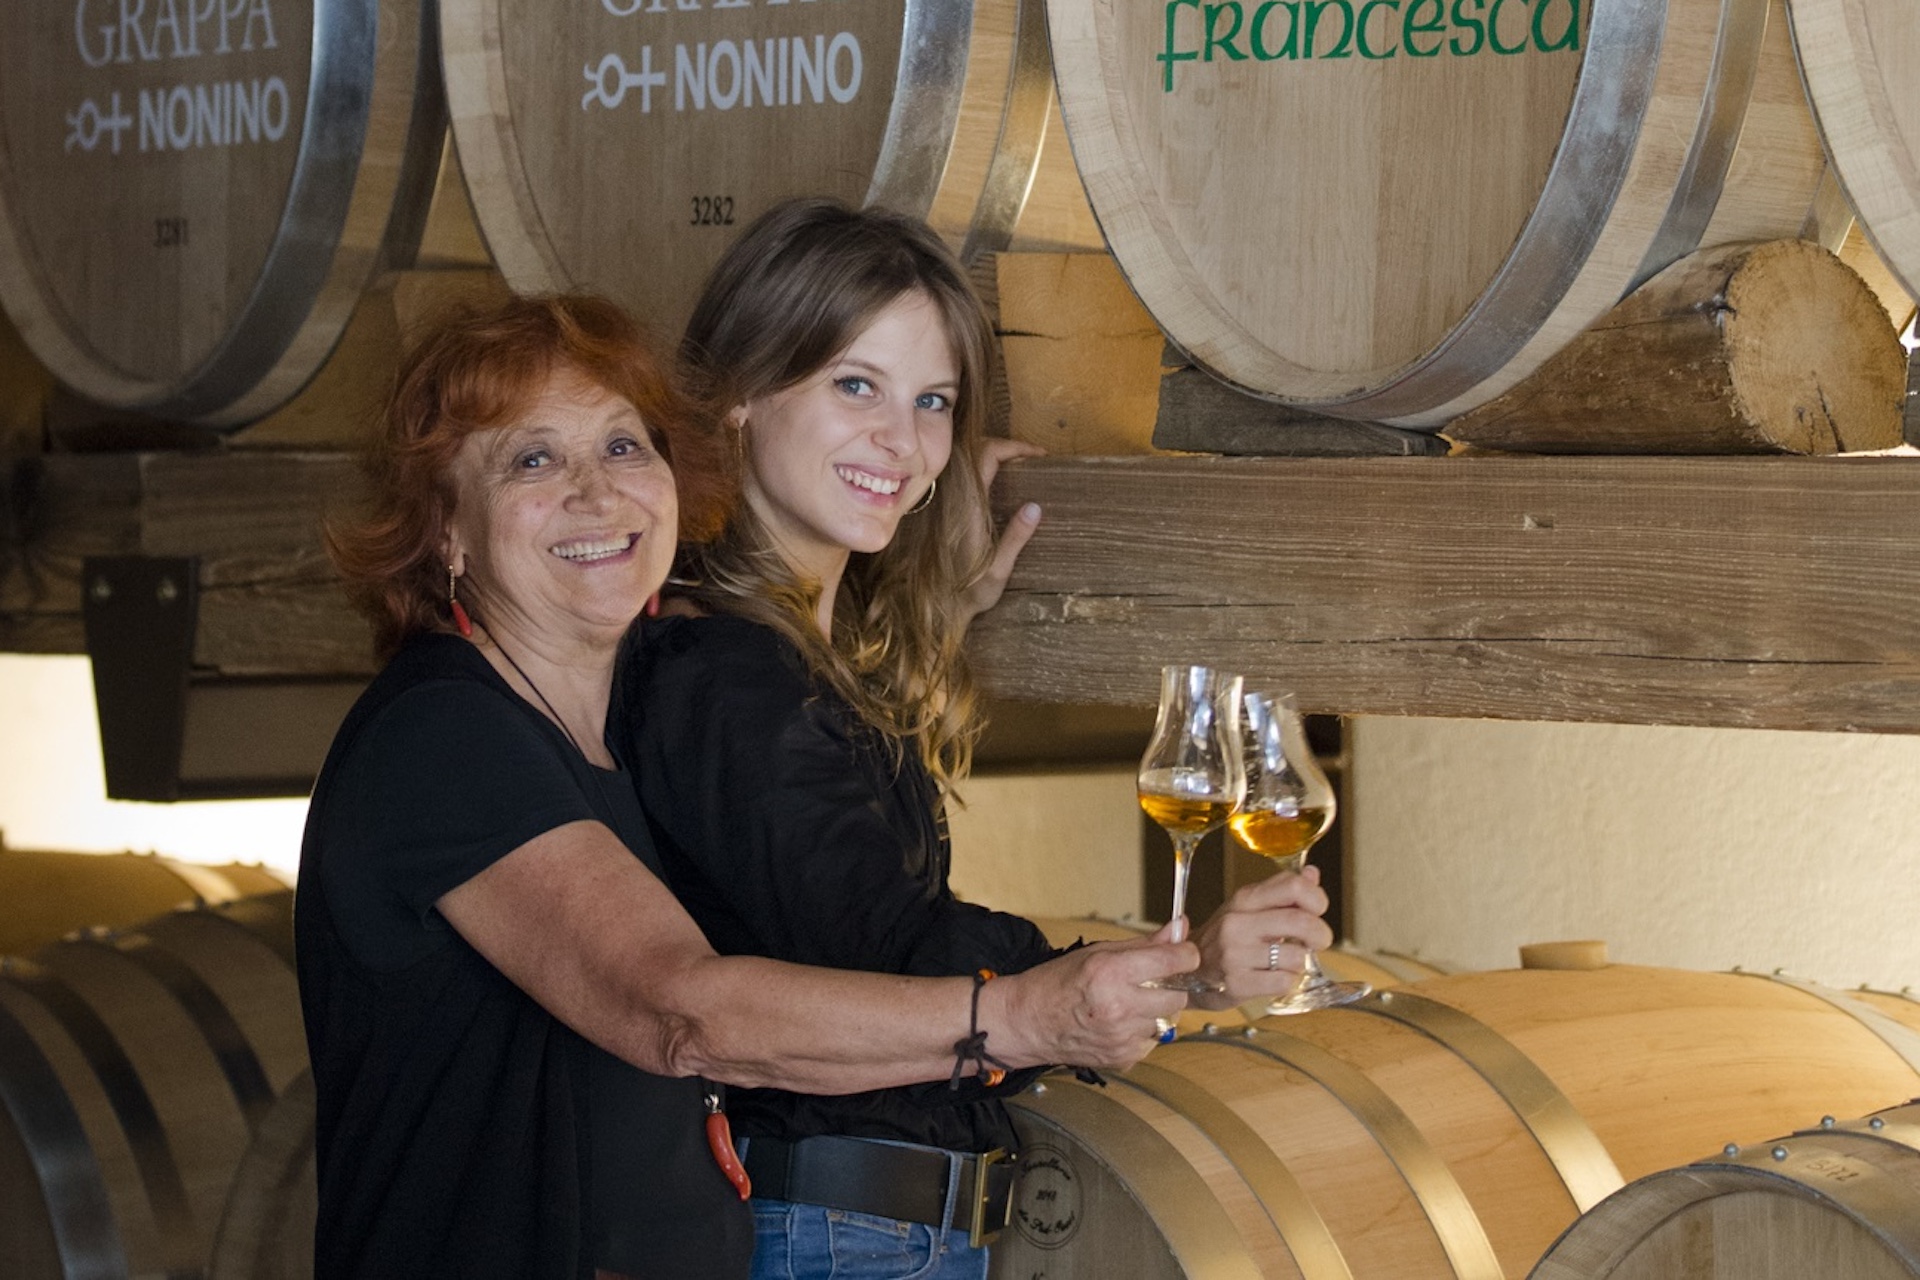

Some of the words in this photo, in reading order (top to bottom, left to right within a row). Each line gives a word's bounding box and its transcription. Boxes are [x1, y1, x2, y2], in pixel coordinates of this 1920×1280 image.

[675, 31, 863, 111] NONINO
[138, 75, 290, 153] NONINO
[690, 195, 735, 226] 3282
